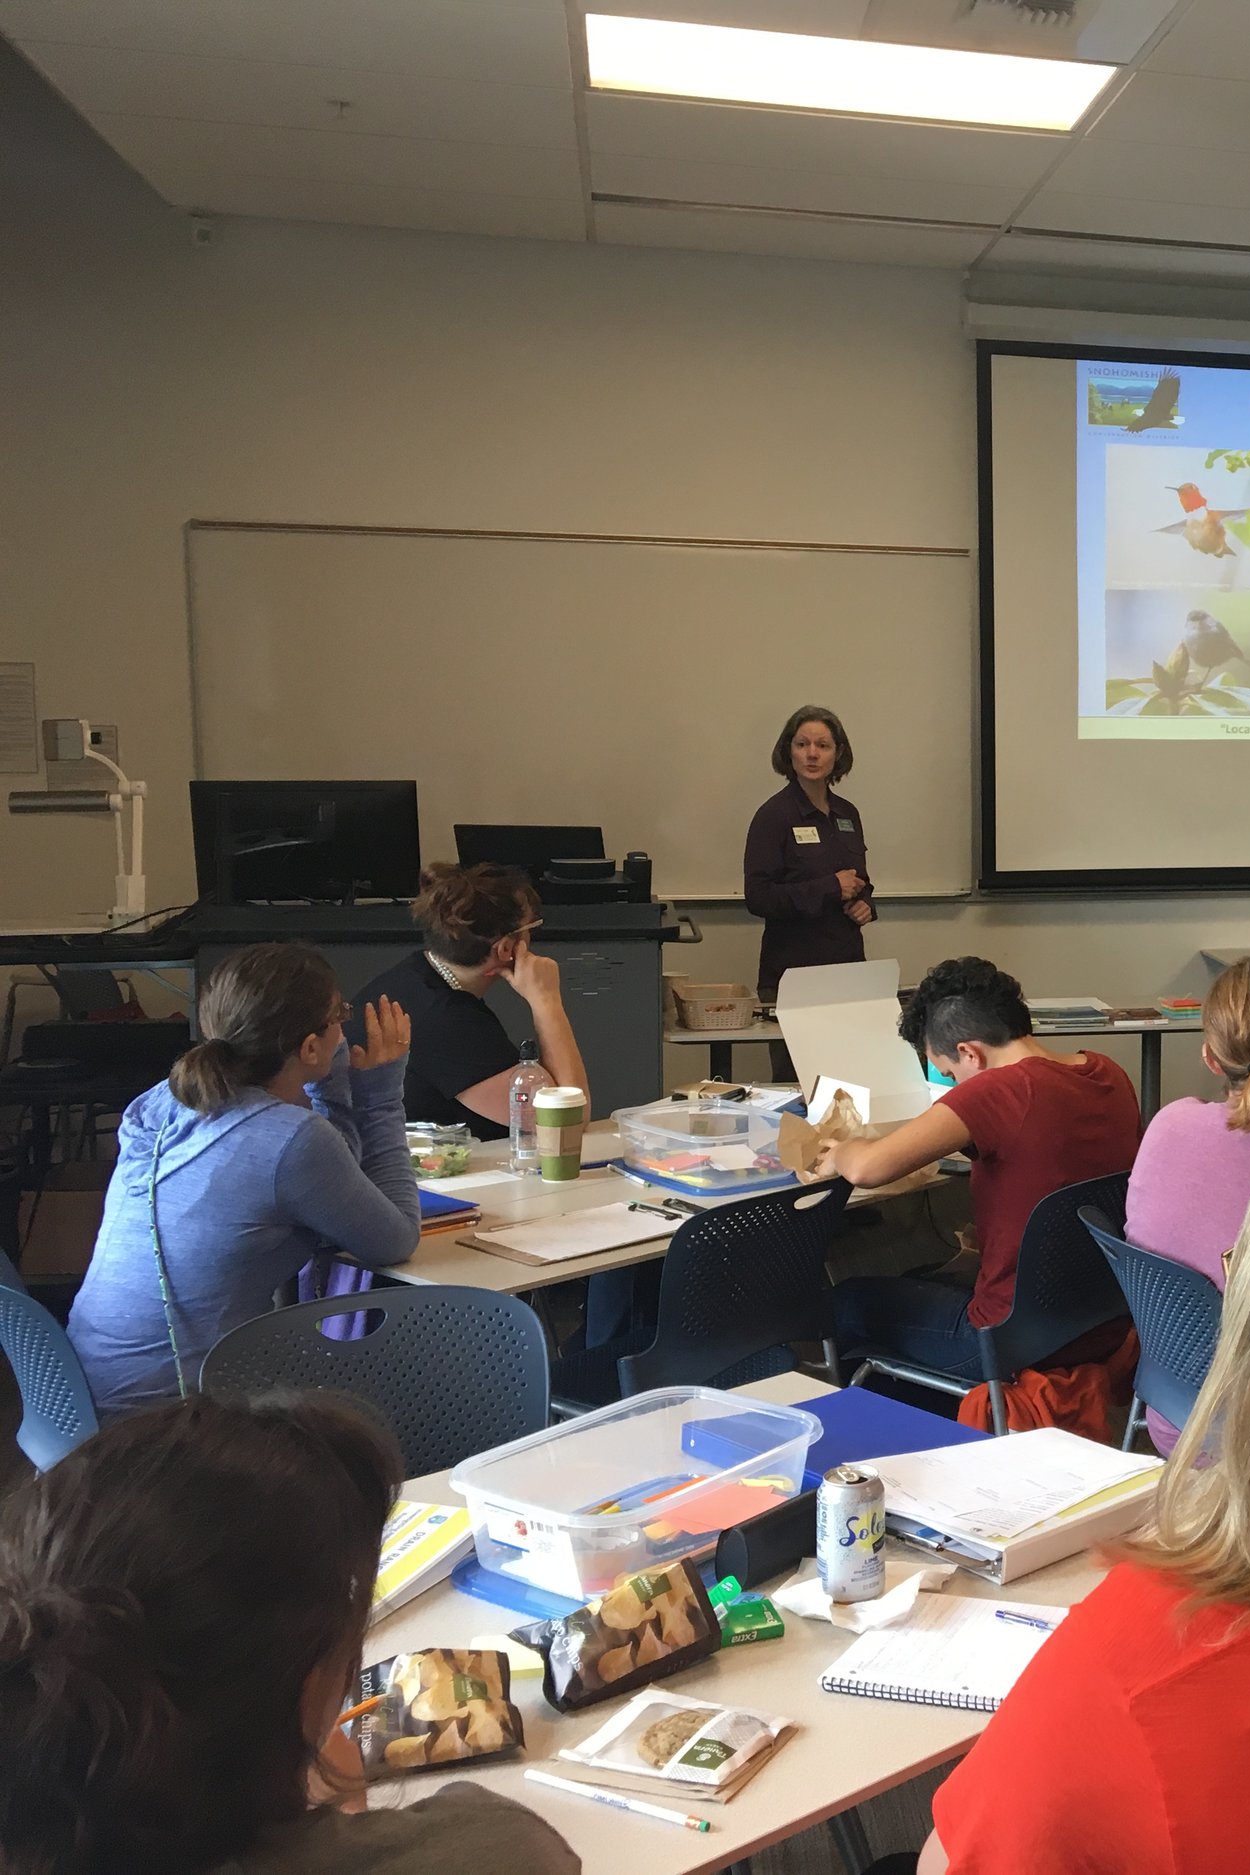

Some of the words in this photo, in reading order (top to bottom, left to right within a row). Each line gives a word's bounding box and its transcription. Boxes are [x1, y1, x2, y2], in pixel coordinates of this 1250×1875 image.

[1087, 367, 1159, 379] SNOHOMISH
[839, 1512, 885, 1547] Sole
[398, 1531, 426, 1552] DRAIN
[731, 1630, 757, 1643] Extra
[357, 1713, 377, 1749] chips
